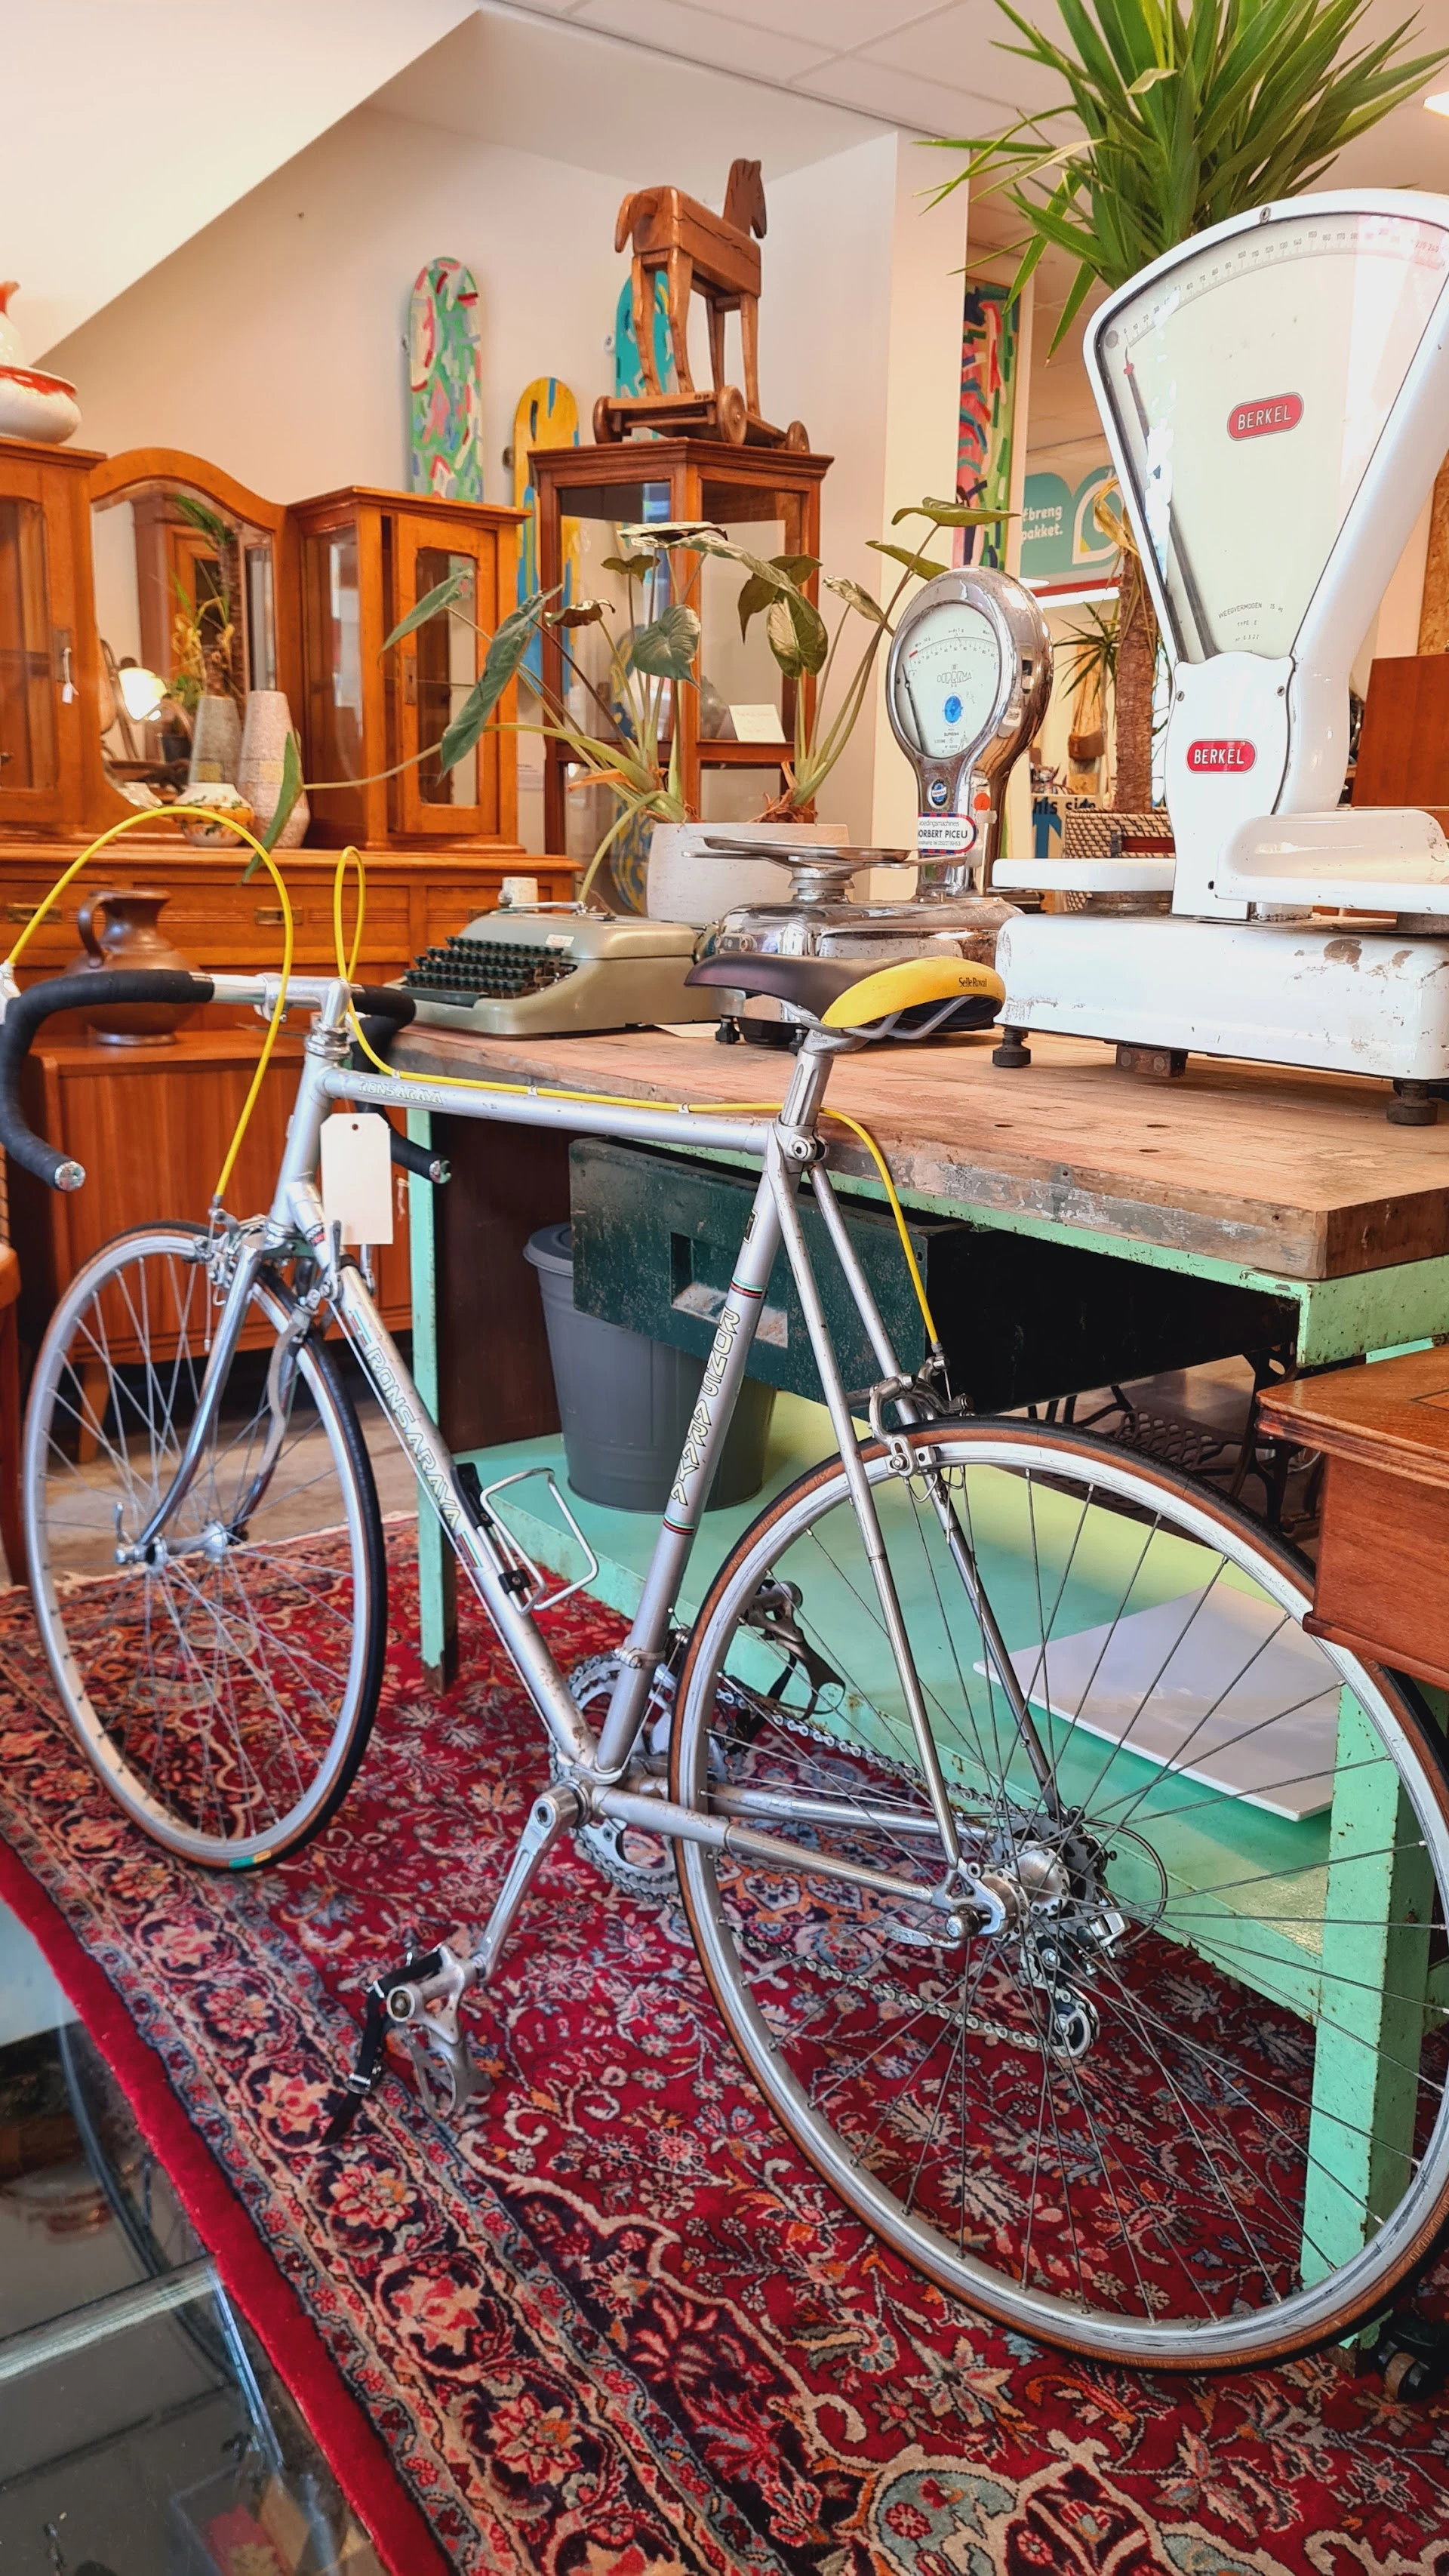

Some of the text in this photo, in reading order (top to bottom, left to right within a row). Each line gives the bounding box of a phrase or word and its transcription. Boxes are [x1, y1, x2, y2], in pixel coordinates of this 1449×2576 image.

[1237, 405, 1292, 430] BERKEL
[1218, 602, 1263, 619] WEEGVERMOGEN
[1193, 748, 1244, 765] BERKEL
[1032, 796, 1057, 814] his
[945, 829, 968, 839] PICEU
[958, 977, 972, 987] Selle
